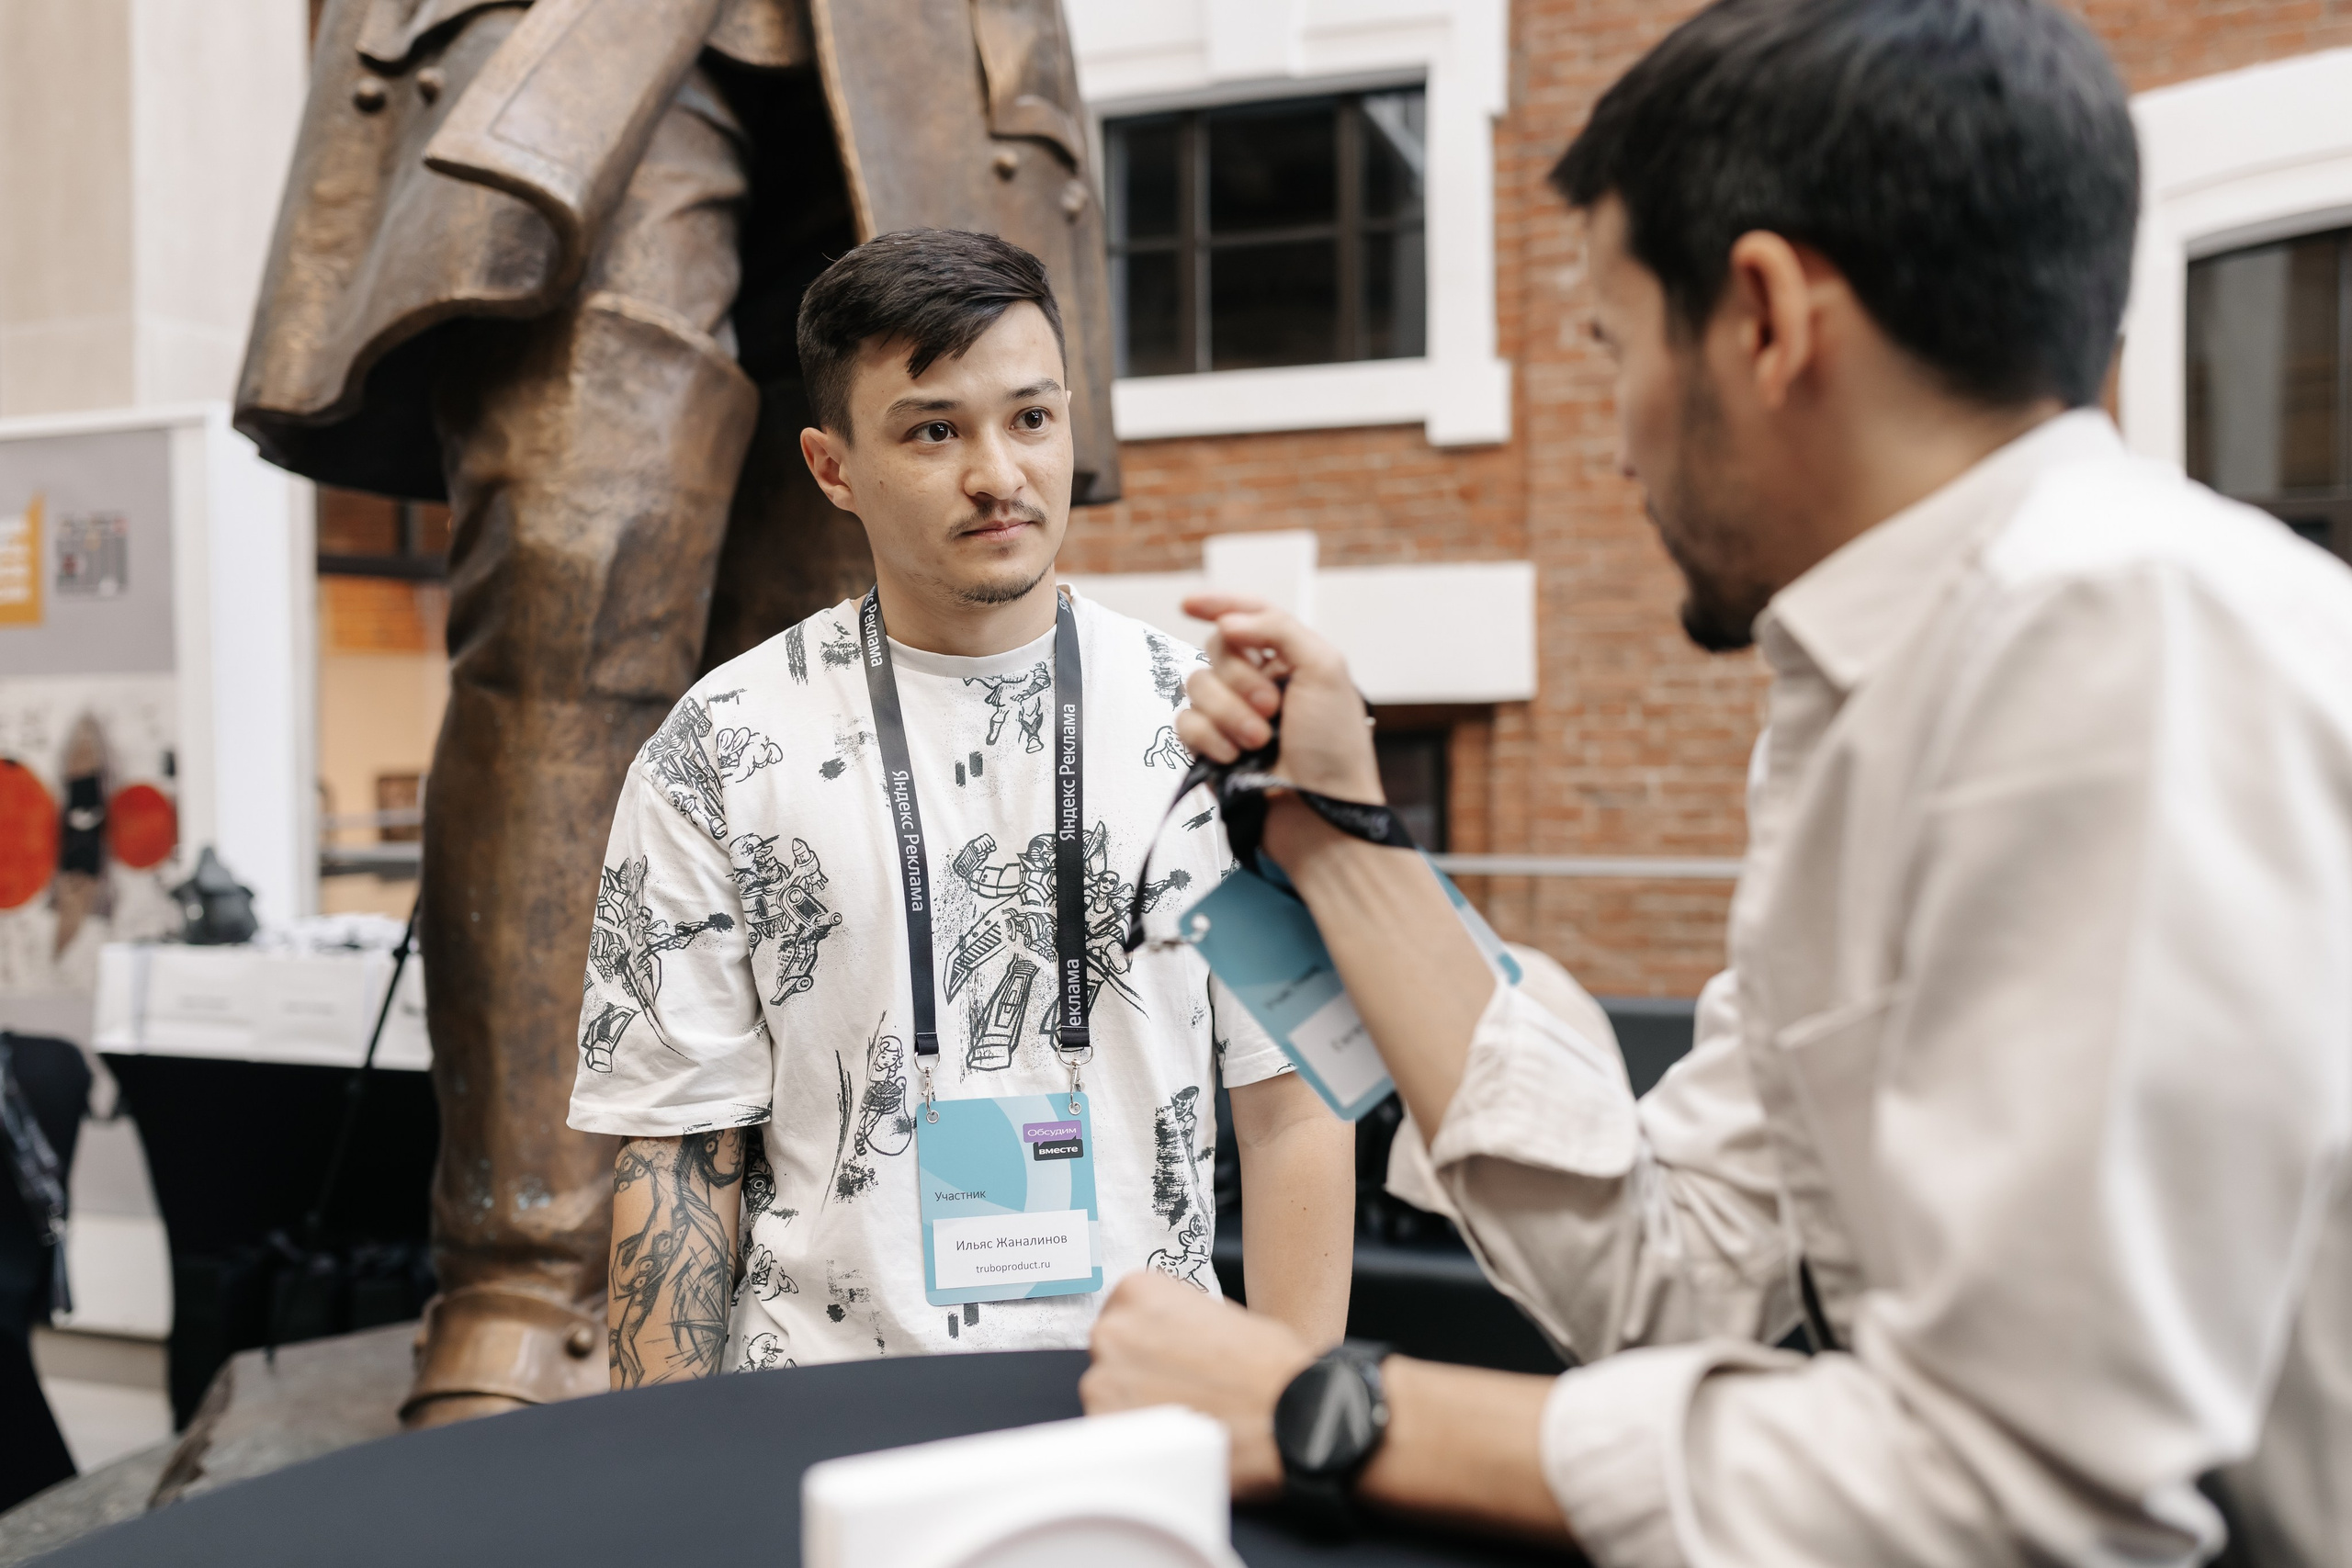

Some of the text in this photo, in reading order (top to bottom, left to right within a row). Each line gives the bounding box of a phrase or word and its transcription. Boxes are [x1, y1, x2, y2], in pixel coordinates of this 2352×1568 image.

[865, 603, 883, 668] Реклама
[1058, 704, 1078, 840] Яндекс Реклама
[892, 770, 923, 912] Яндекс Реклама
[1027, 1127, 1077, 1137] Обсудим
[1038, 1145, 1079, 1156] вместе
[934, 1190, 987, 1202] Участник
[956, 1235, 1068, 1251] Ильяс Жаналинов
[976, 1261, 1051, 1274] truboproduct.ru
